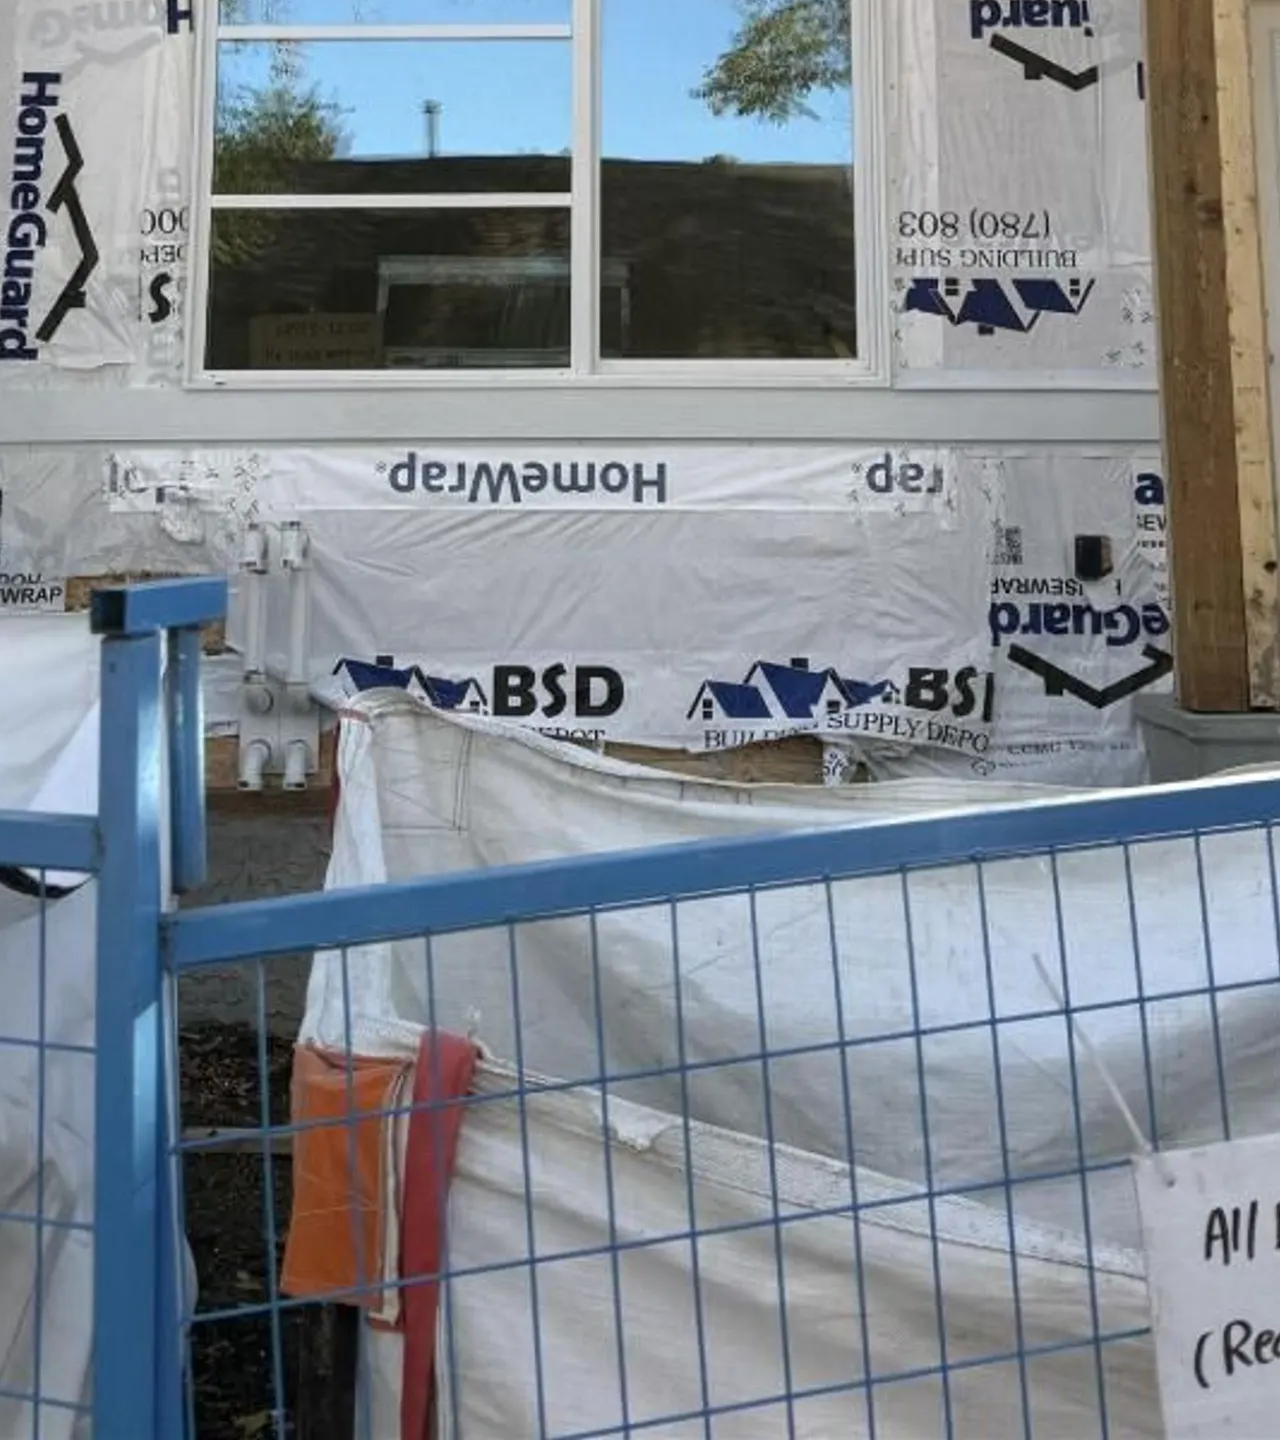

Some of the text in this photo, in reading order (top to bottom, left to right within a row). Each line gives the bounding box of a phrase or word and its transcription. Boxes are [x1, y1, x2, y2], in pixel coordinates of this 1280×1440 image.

[970, 207, 1050, 239] (780)
[960, 248, 1077, 268] BUILDING
[389, 452, 667, 503] HomeWrap
[990, 578, 1084, 596] SEWRAP
[492, 663, 624, 718] BSD
[906, 666, 994, 724] BS
[827, 712, 922, 739] SUPPLY
[1204, 1199, 1258, 1266] All
